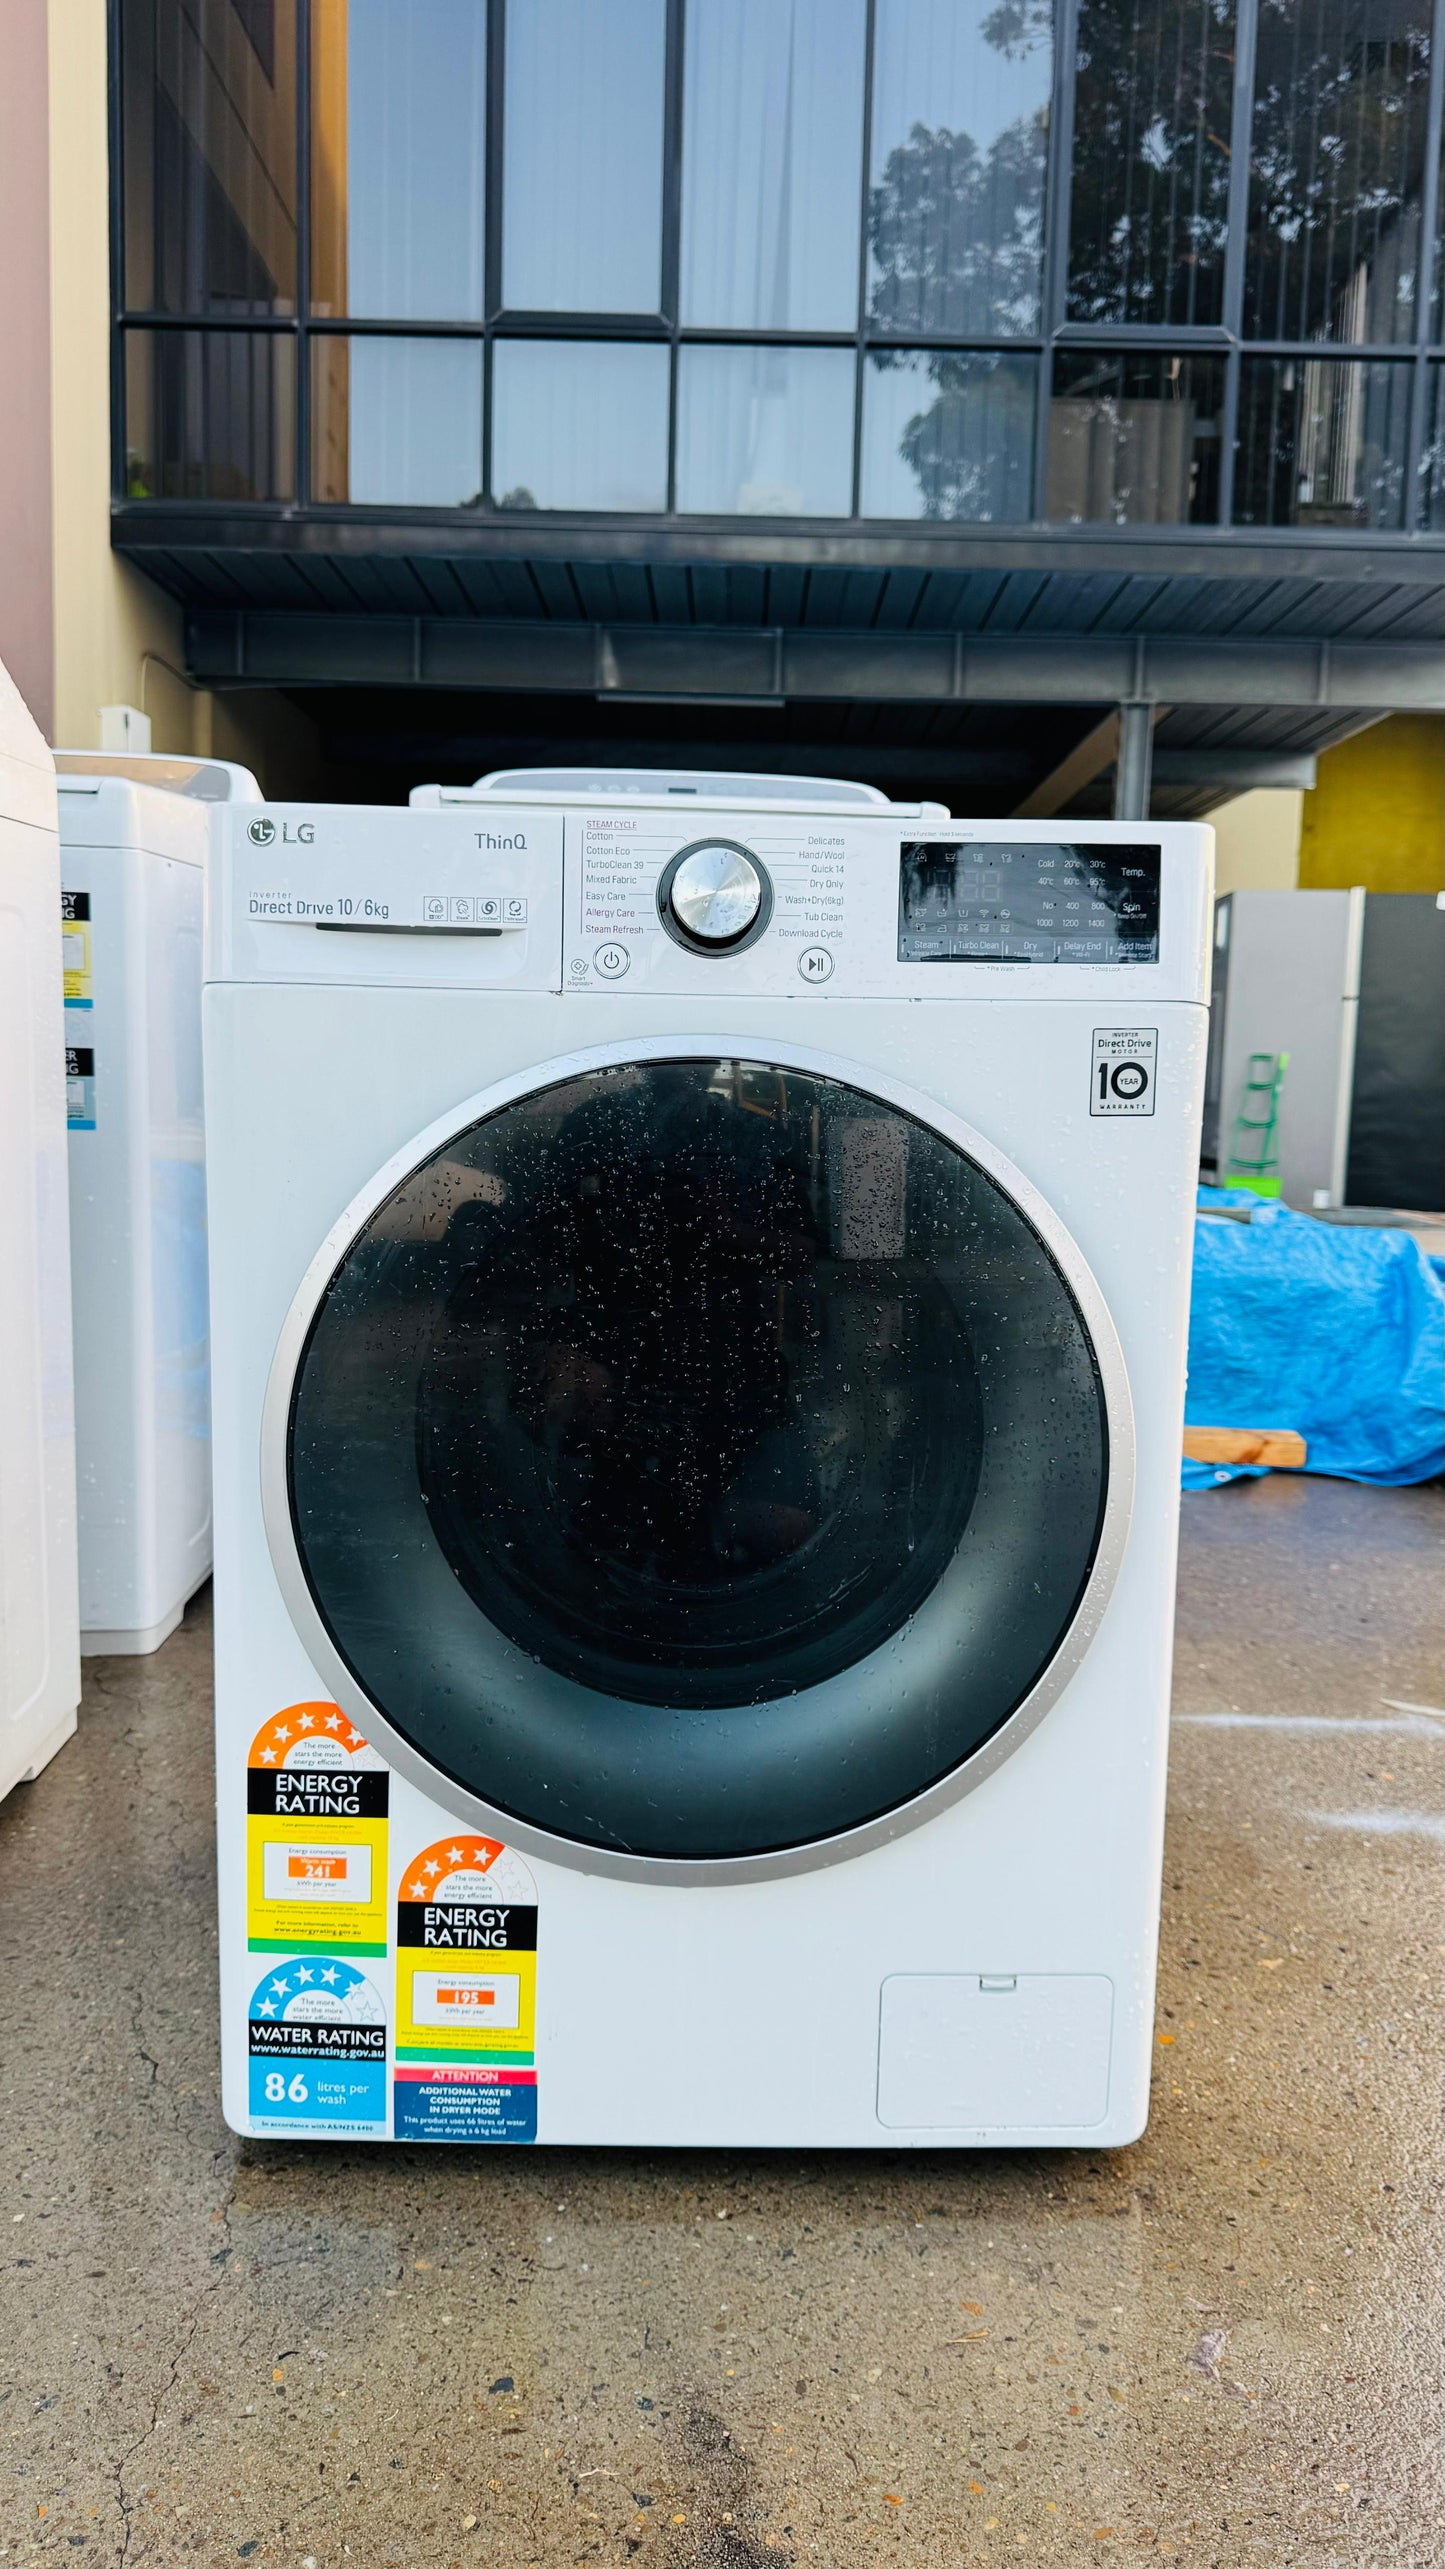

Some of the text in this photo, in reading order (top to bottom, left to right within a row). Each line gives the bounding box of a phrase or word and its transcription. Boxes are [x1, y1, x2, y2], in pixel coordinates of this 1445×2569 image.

[586, 820, 637, 830] STEAM CYCLE
[283, 822, 315, 844] LG
[586, 832, 614, 841] Cotton
[474, 832, 528, 850] ThinQ
[808, 836, 845, 846] Delicates
[586, 846, 631, 855] Cotton Eco
[799, 851, 845, 860] Hand/Wool
[586, 860, 644, 870] TurboClean 39
[1037, 859, 1055, 868] Cold
[811, 864, 845, 874] Quick 14
[1121, 867, 1146, 877] Temp.
[586, 874, 637, 884] Mixed Fabric
[809, 879, 844, 891] Dry Only
[249, 890, 293, 899] Inverter
[586, 891, 626, 902] Easy Care
[785, 895, 844, 906] Wash+Dry(6kg)
[249, 899, 293, 914] Direct
[296, 900, 334, 915] Drive
[1042, 902, 1105, 910] No 400 800
[1122, 902, 1141, 913] Spin
[586, 908, 635, 919] Allergy Care
[804, 912, 844, 922] Tub Clean
[1036, 919, 1105, 927] 1000 1200 1400
[585, 925, 644, 935] Steam Refresh
[778, 928, 843, 940] Download Cycle
[914, 941, 939, 949] Steam
[959, 941, 999, 950] Turbo Clean
[1023, 941, 1038, 952] Dry
[1064, 941, 1102, 951] Delay End
[1118, 942, 1153, 950] Add Item
[1098, 1039, 1152, 1048] Direct Drive
[1098, 1061, 1149, 1100] 10
[303, 1741, 316, 1749] The
[275, 1774, 363, 1794] ENERGY
[275, 1795, 360, 1815] RATING
[305, 1865, 331, 1878] 241
[424, 1907, 510, 1927] ENERGY
[424, 1927, 508, 1948] RATING
[301, 1997, 314, 2006] The
[454, 1990, 479, 2004] 195
[251, 2026, 313, 2044] WATER
[317, 2030, 384, 2046] RATING
[250, 2044, 385, 2059] www.waterrating.gov.au
[432, 2070, 499, 2082] ATTENTION
[264, 2072, 309, 2103] 86
[317, 2081, 370, 2095] litres per
[418, 2086, 511, 2097] ADDITIONAL WATER
[317, 2094, 347, 2105] wash
[429, 2097, 500, 2106] CONSUMPTION
[429, 2106, 501, 2116] IN DRYER MODE
[403, 2115, 419, 2123] This
[420, 2116, 448, 2126] product
[477, 2118, 496, 2126] litres
[498, 2118, 506, 2126] of
[424, 2126, 444, 2134] when
[444, 2126, 467, 2136] drying
[490, 2127, 507, 2136] load
